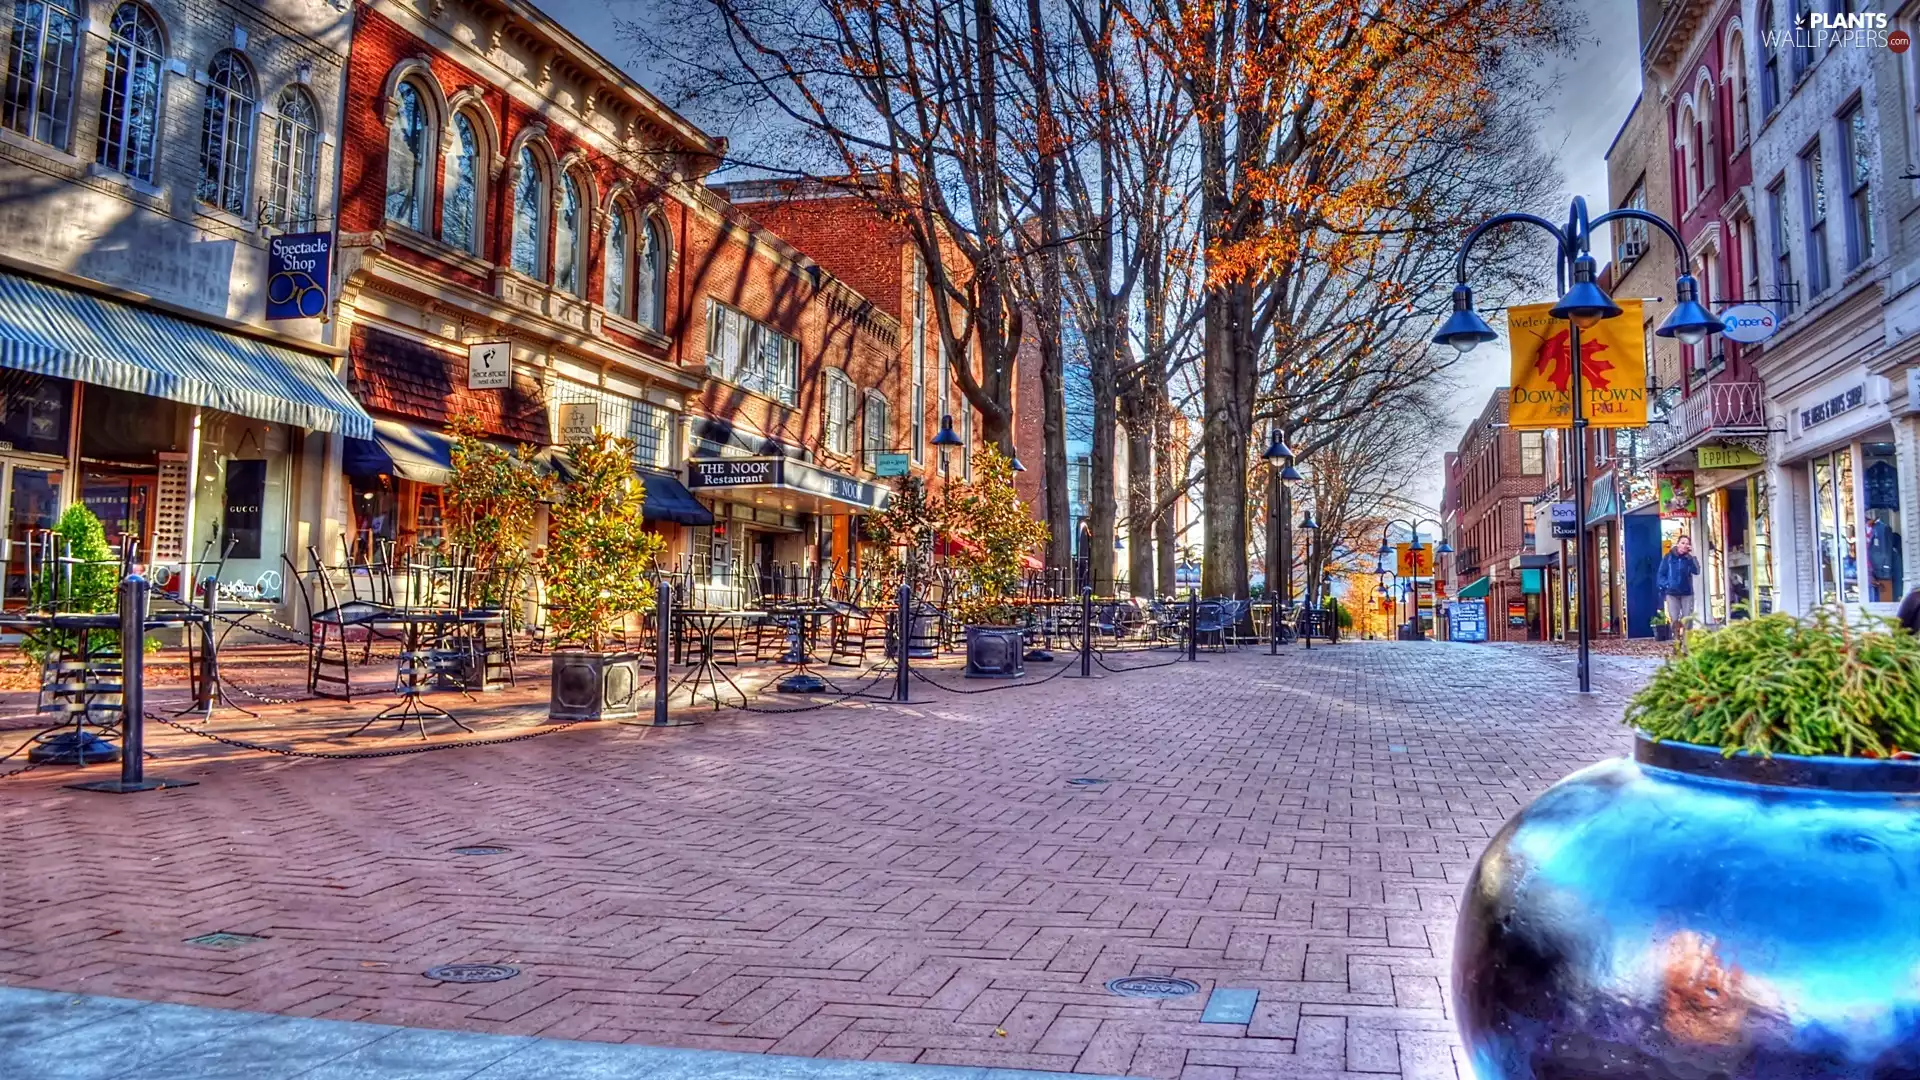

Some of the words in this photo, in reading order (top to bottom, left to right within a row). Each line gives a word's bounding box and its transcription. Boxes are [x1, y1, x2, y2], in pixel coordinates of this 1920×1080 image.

[272, 238, 328, 258] Spectacle
[283, 254, 316, 273] Shop
[1738, 316, 1772, 328] openQ
[1512, 384, 1570, 404] DOWN
[1586, 388, 1643, 402] TOWN
[698, 463, 725, 474] THE
[730, 462, 770, 474] NOOK
[704, 474, 764, 485] Restaurant
[823, 476, 839, 494] THE
[841, 480, 863, 500] NOOK
[229, 505, 259, 513] GUCCI
